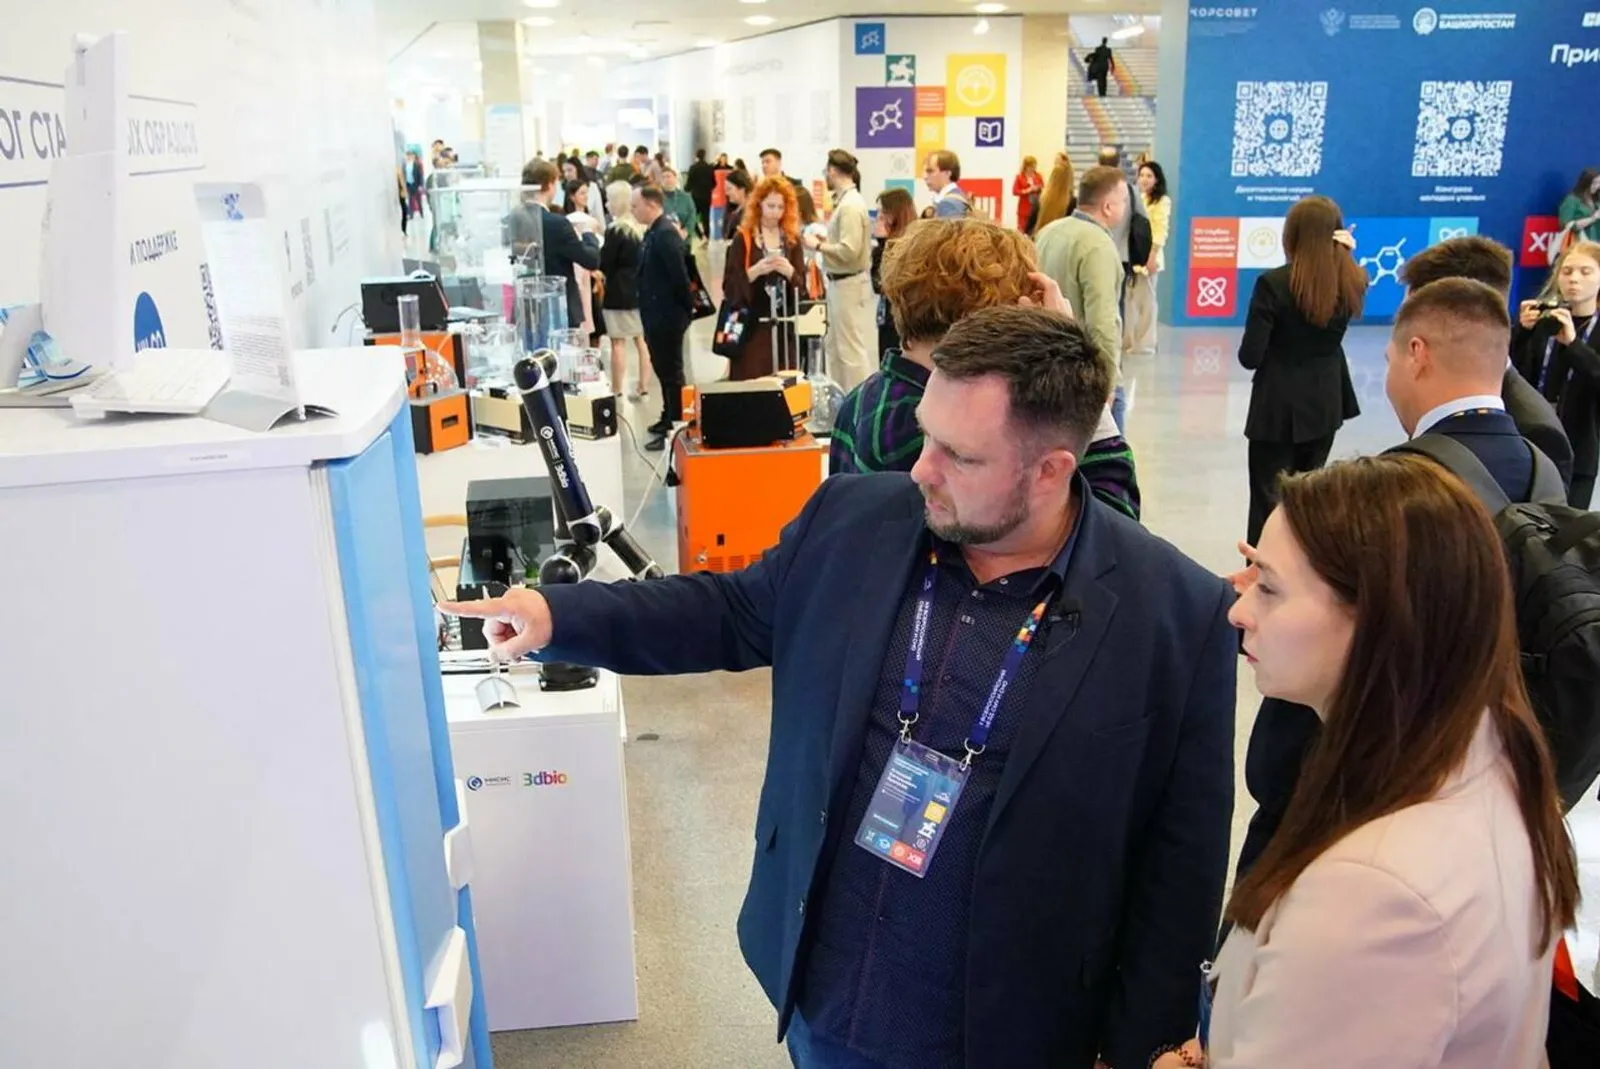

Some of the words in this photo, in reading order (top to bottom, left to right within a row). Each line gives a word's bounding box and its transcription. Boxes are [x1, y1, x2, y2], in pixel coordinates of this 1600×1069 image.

[1550, 43, 1600, 68] При
[554, 463, 569, 488] 3dbio
[522, 770, 568, 786] 3dbio
